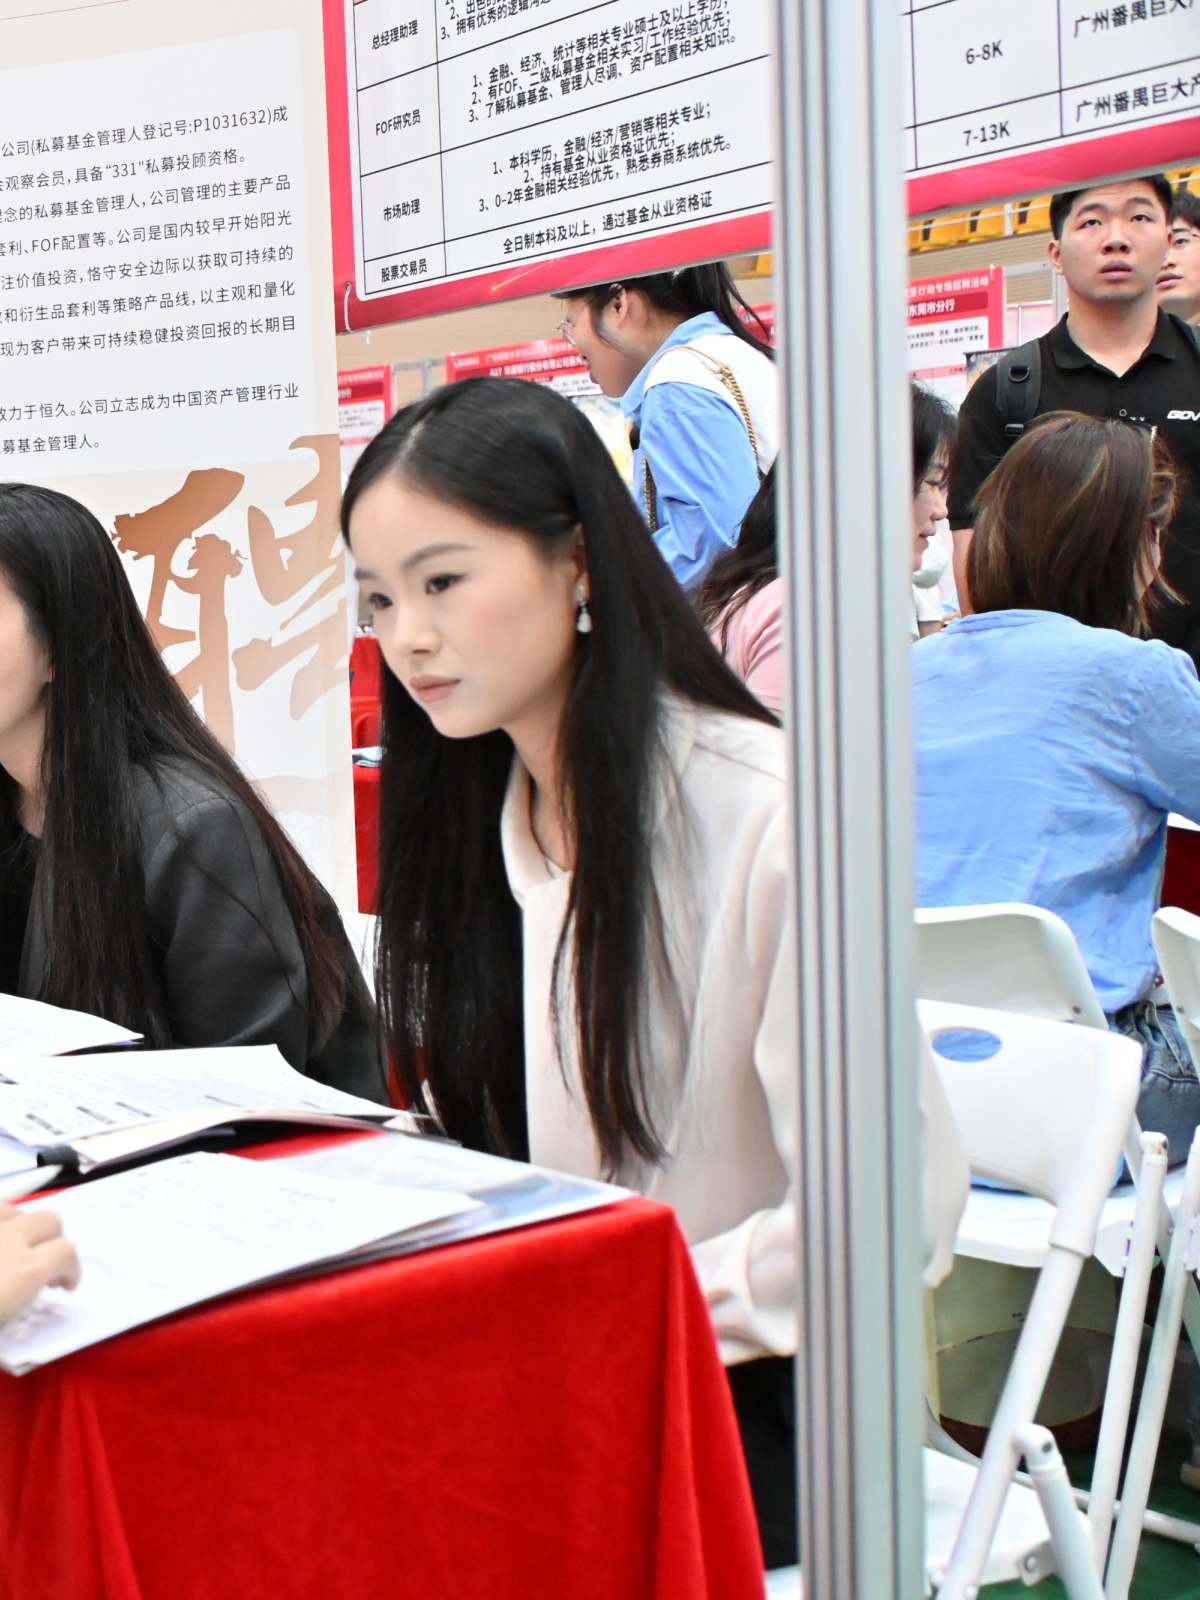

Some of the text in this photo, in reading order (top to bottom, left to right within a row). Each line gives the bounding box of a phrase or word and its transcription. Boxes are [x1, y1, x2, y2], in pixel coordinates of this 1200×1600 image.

[371, 20, 419, 50] 总经理助理
[441, 0, 551, 40] 3、拥有优秀的逻辑
[1073, 0, 1194, 38] 广州番禺巨大
[965, 40, 1004, 66] 6-8K
[468, 27, 736, 123] 3、了解私募基金、管理人尽调、资产配置相关知识。
[375, 109, 421, 136] FOF研究员
[493, 101, 712, 175] 1、本科学历，金融/经济/营销等相关专业；
[963, 121, 1011, 147] 7-13K
[479, 134, 732, 213] 3、0-2年金融相关经验优先，熟悉券商系统优先。
[523, 129, 676, 184] 2、持有基金从业资格证优先；
[383, 198, 421, 222] 市场助理
[503, 190, 713, 255] 全日制本科及以上，通过基金从业资格证
[381, 258, 428, 284] 股票交易员
